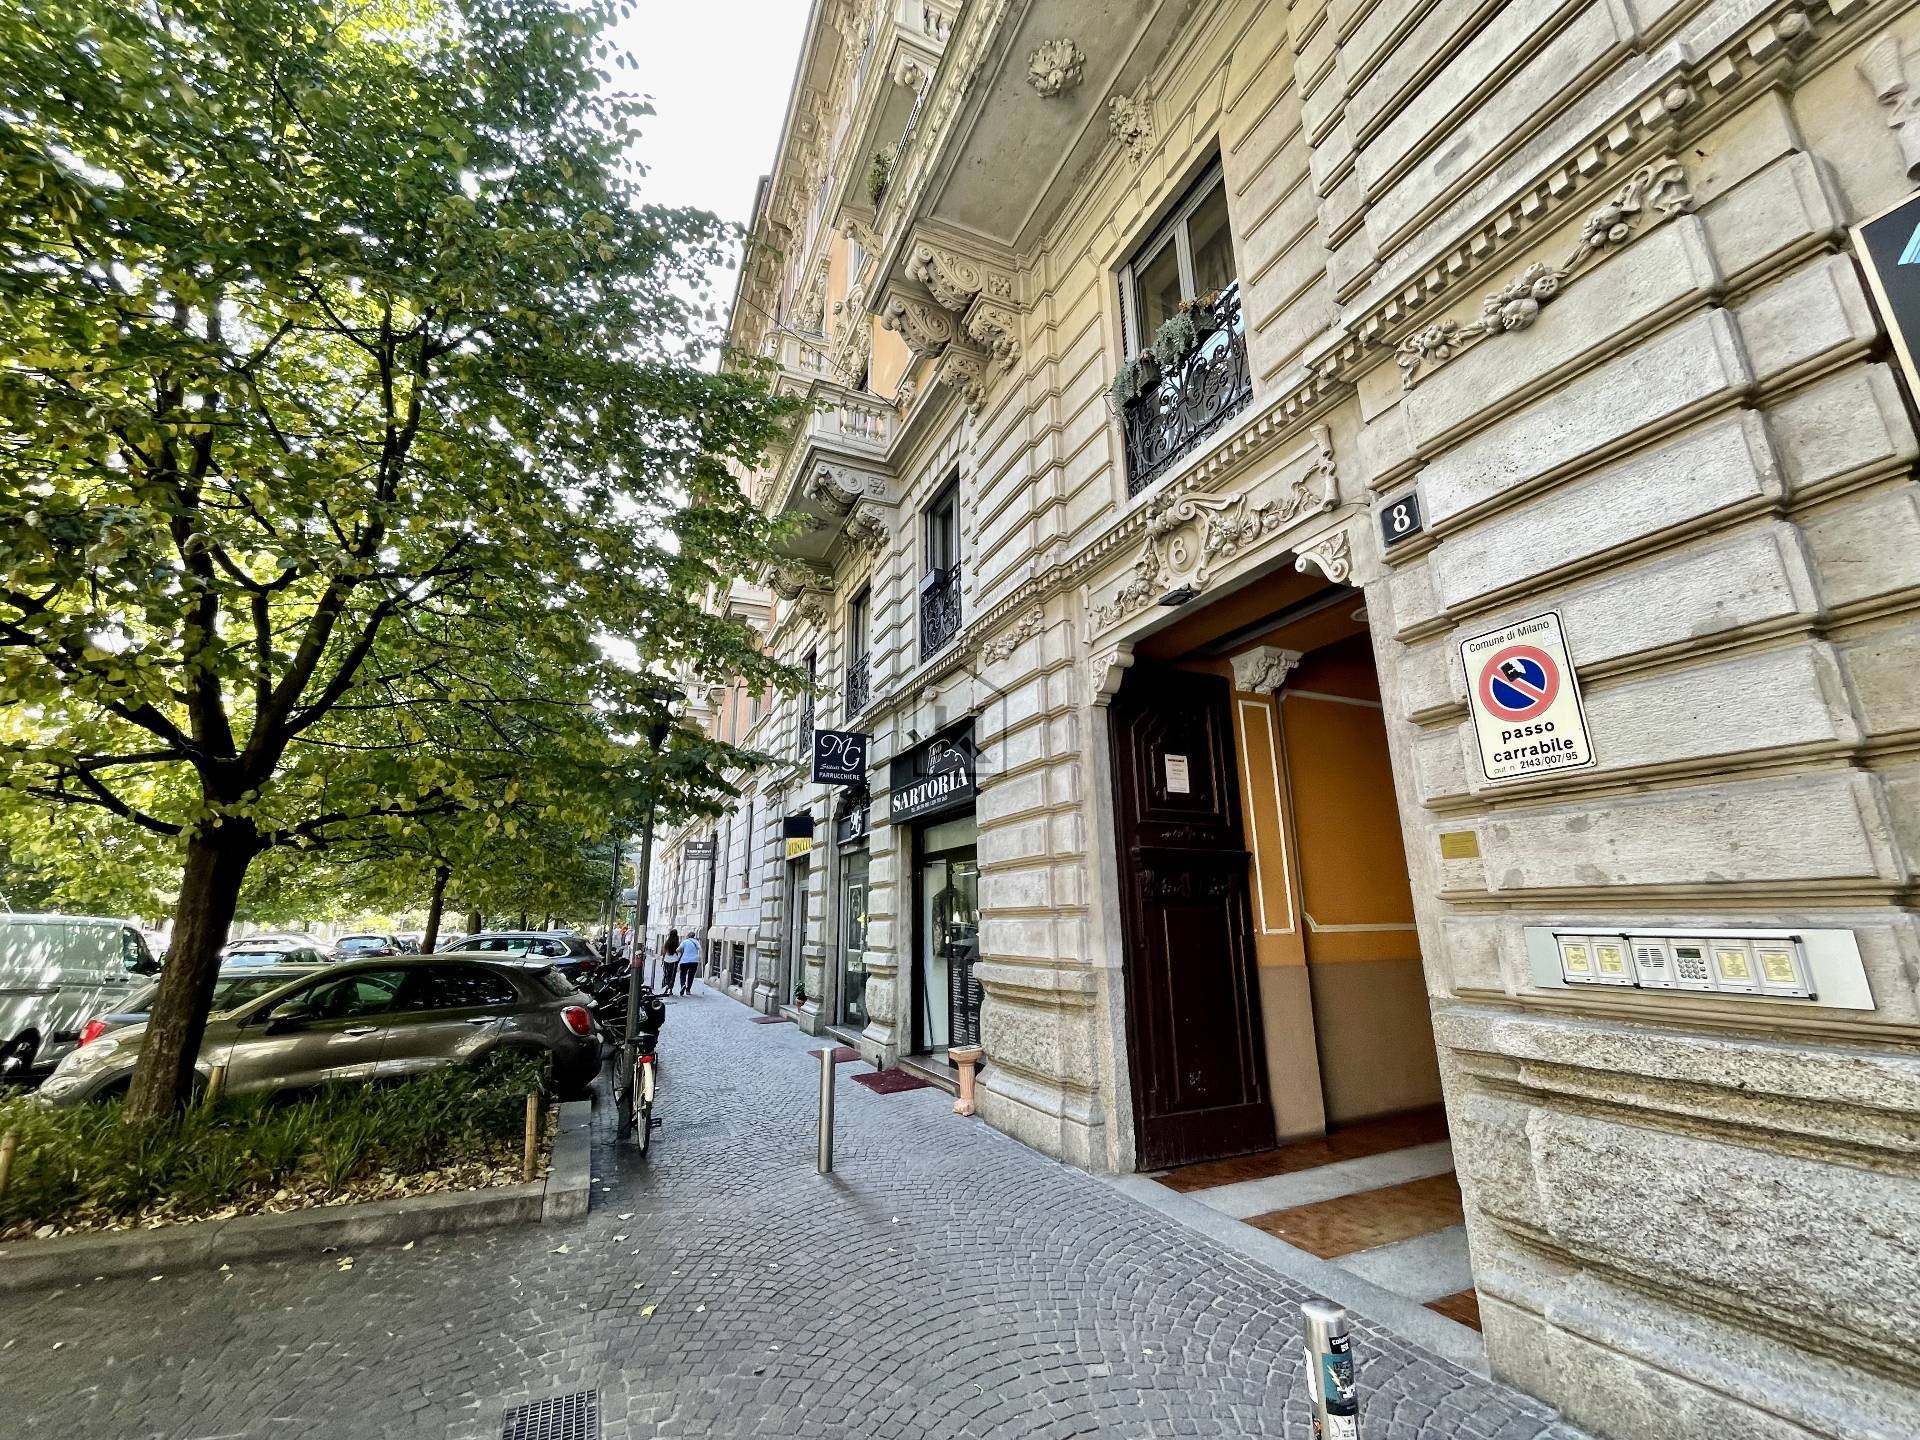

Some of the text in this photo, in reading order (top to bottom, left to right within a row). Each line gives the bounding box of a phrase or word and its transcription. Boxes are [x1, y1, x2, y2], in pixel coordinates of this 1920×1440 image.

[1392, 504, 1411, 533] 8
[1172, 536, 1187, 564] 8
[1469, 620, 1550, 653] Comune di Milano
[1501, 721, 1555, 744] passo
[1493, 737, 1574, 763] carrabile
[1519, 751, 1578, 769] 2143/007/95
[892, 766, 970, 813] SARTORIA
